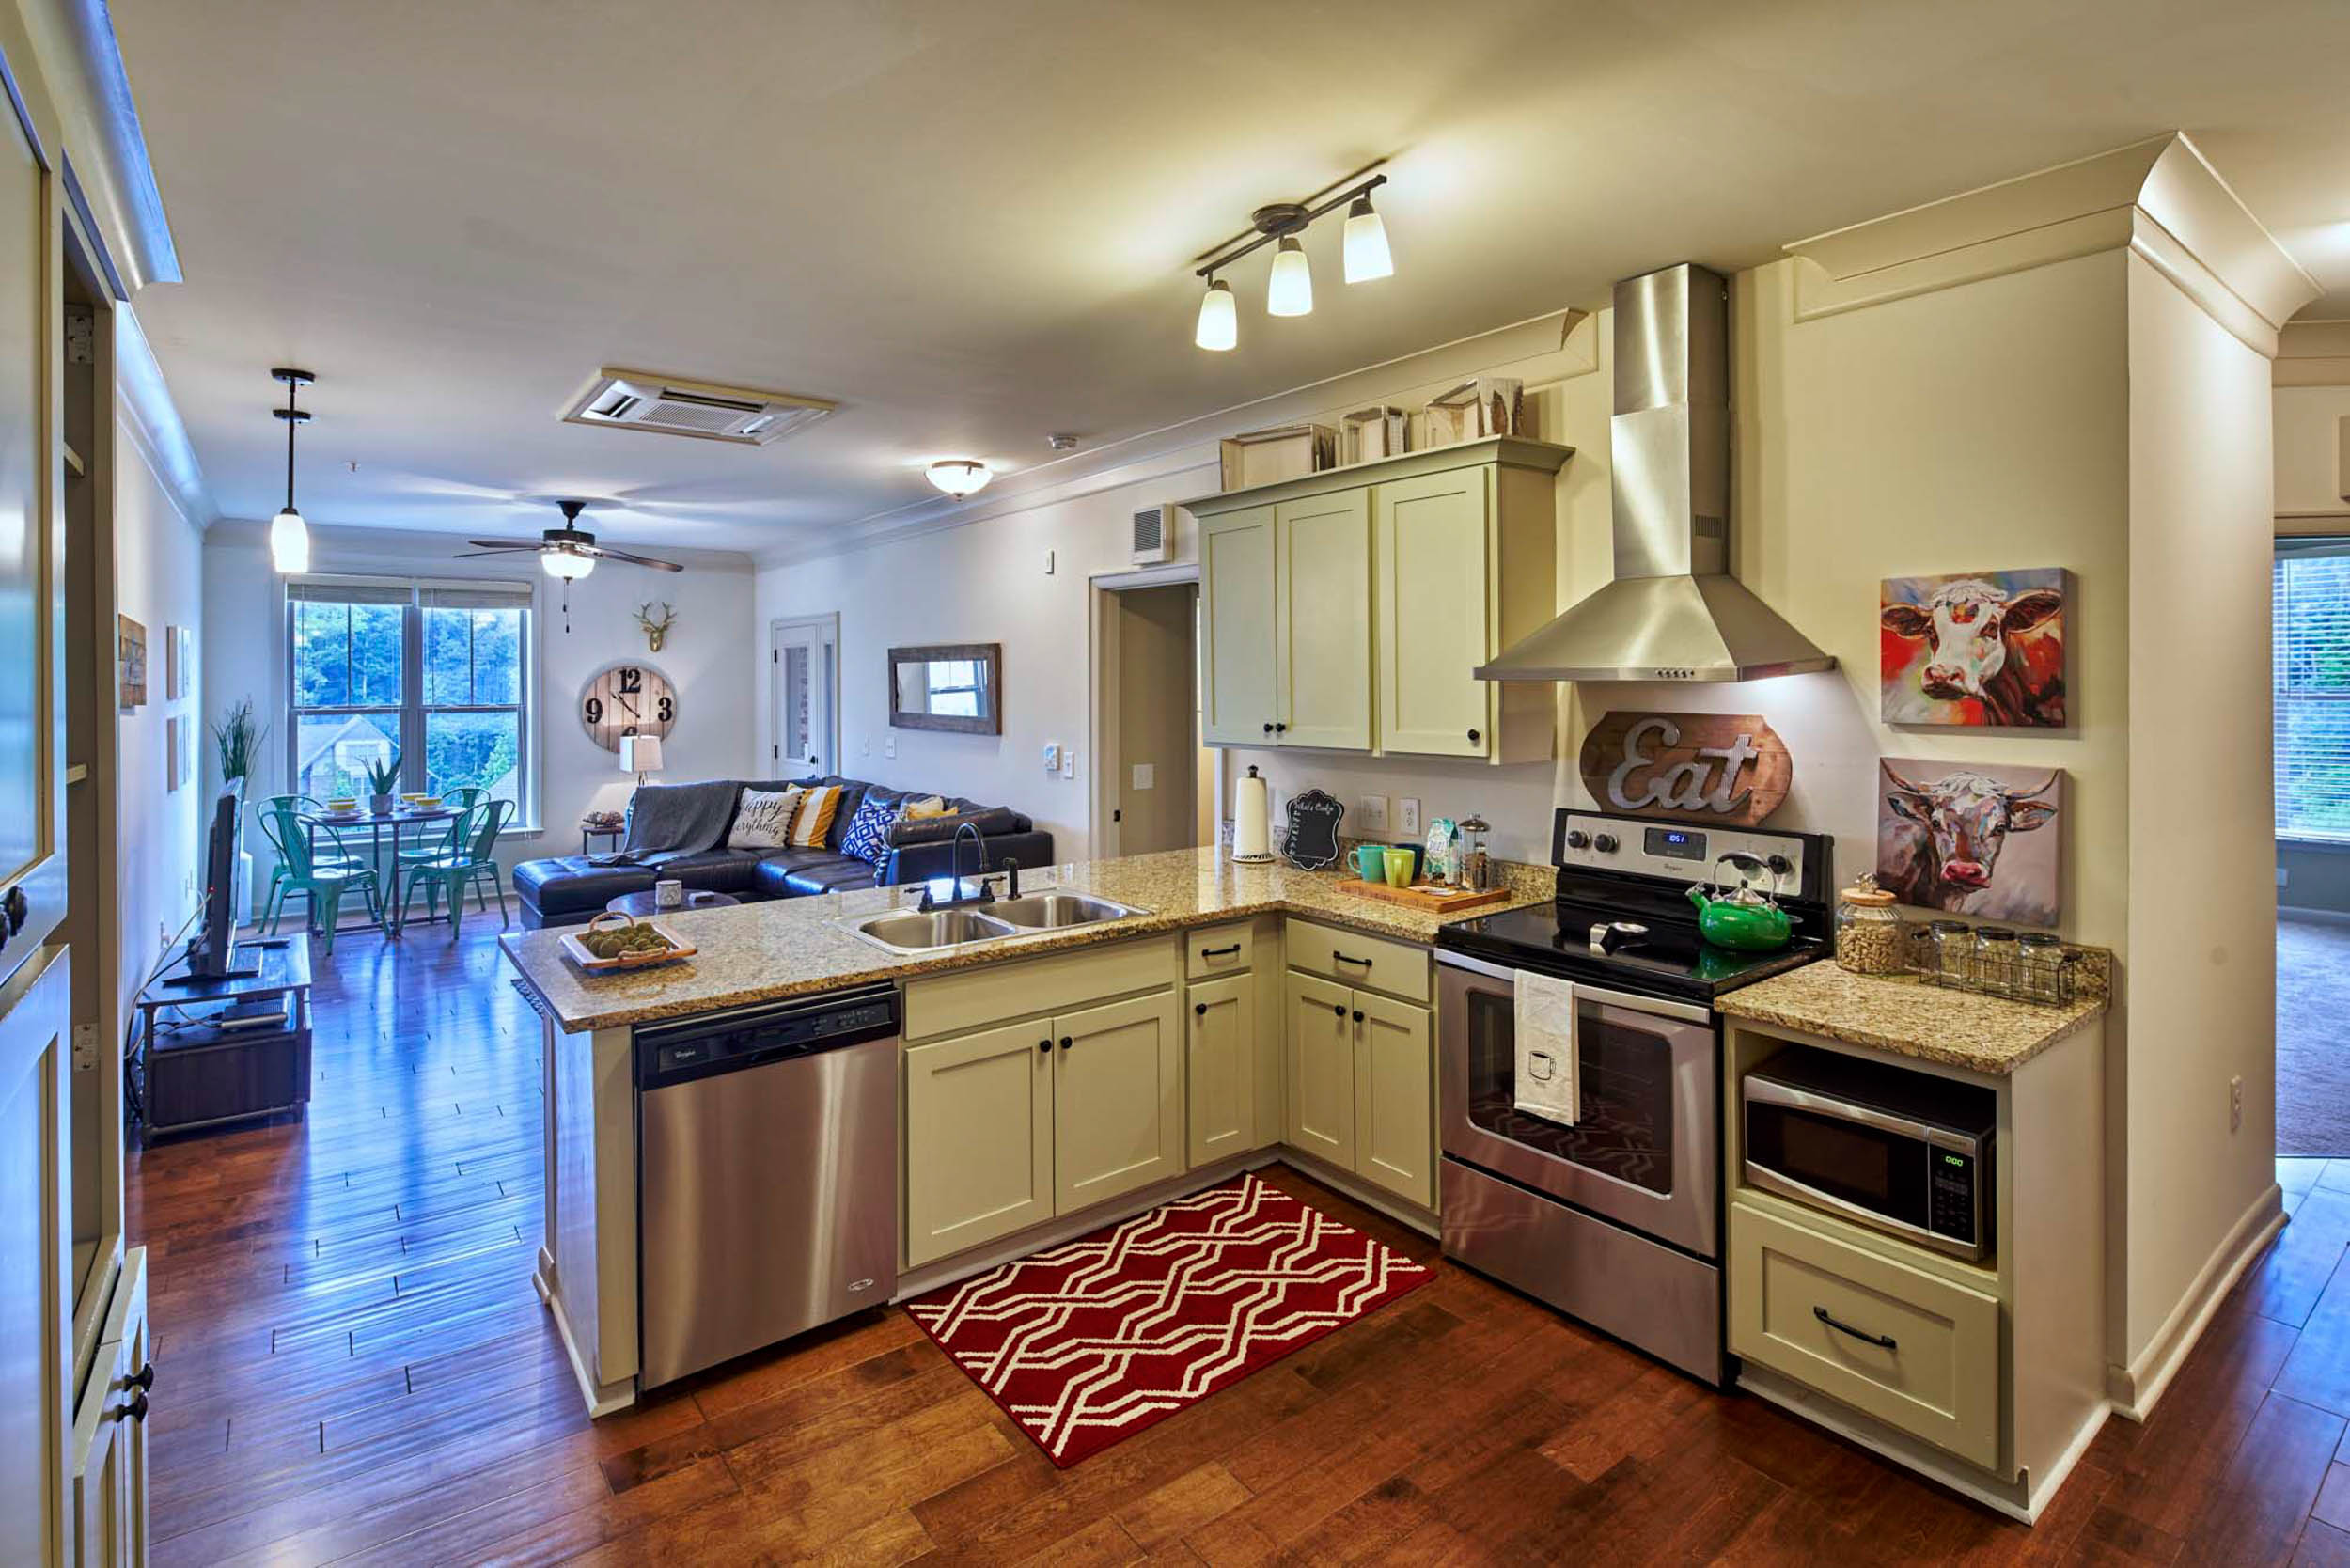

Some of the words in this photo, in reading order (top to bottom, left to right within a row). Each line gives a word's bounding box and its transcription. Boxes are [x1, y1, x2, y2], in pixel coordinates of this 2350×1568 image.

[619, 668, 641, 694] 12
[586, 698, 603, 724] 9
[658, 697, 672, 722] 3
[1608, 717, 1761, 813] Eat
[743, 799, 782, 823] appy
